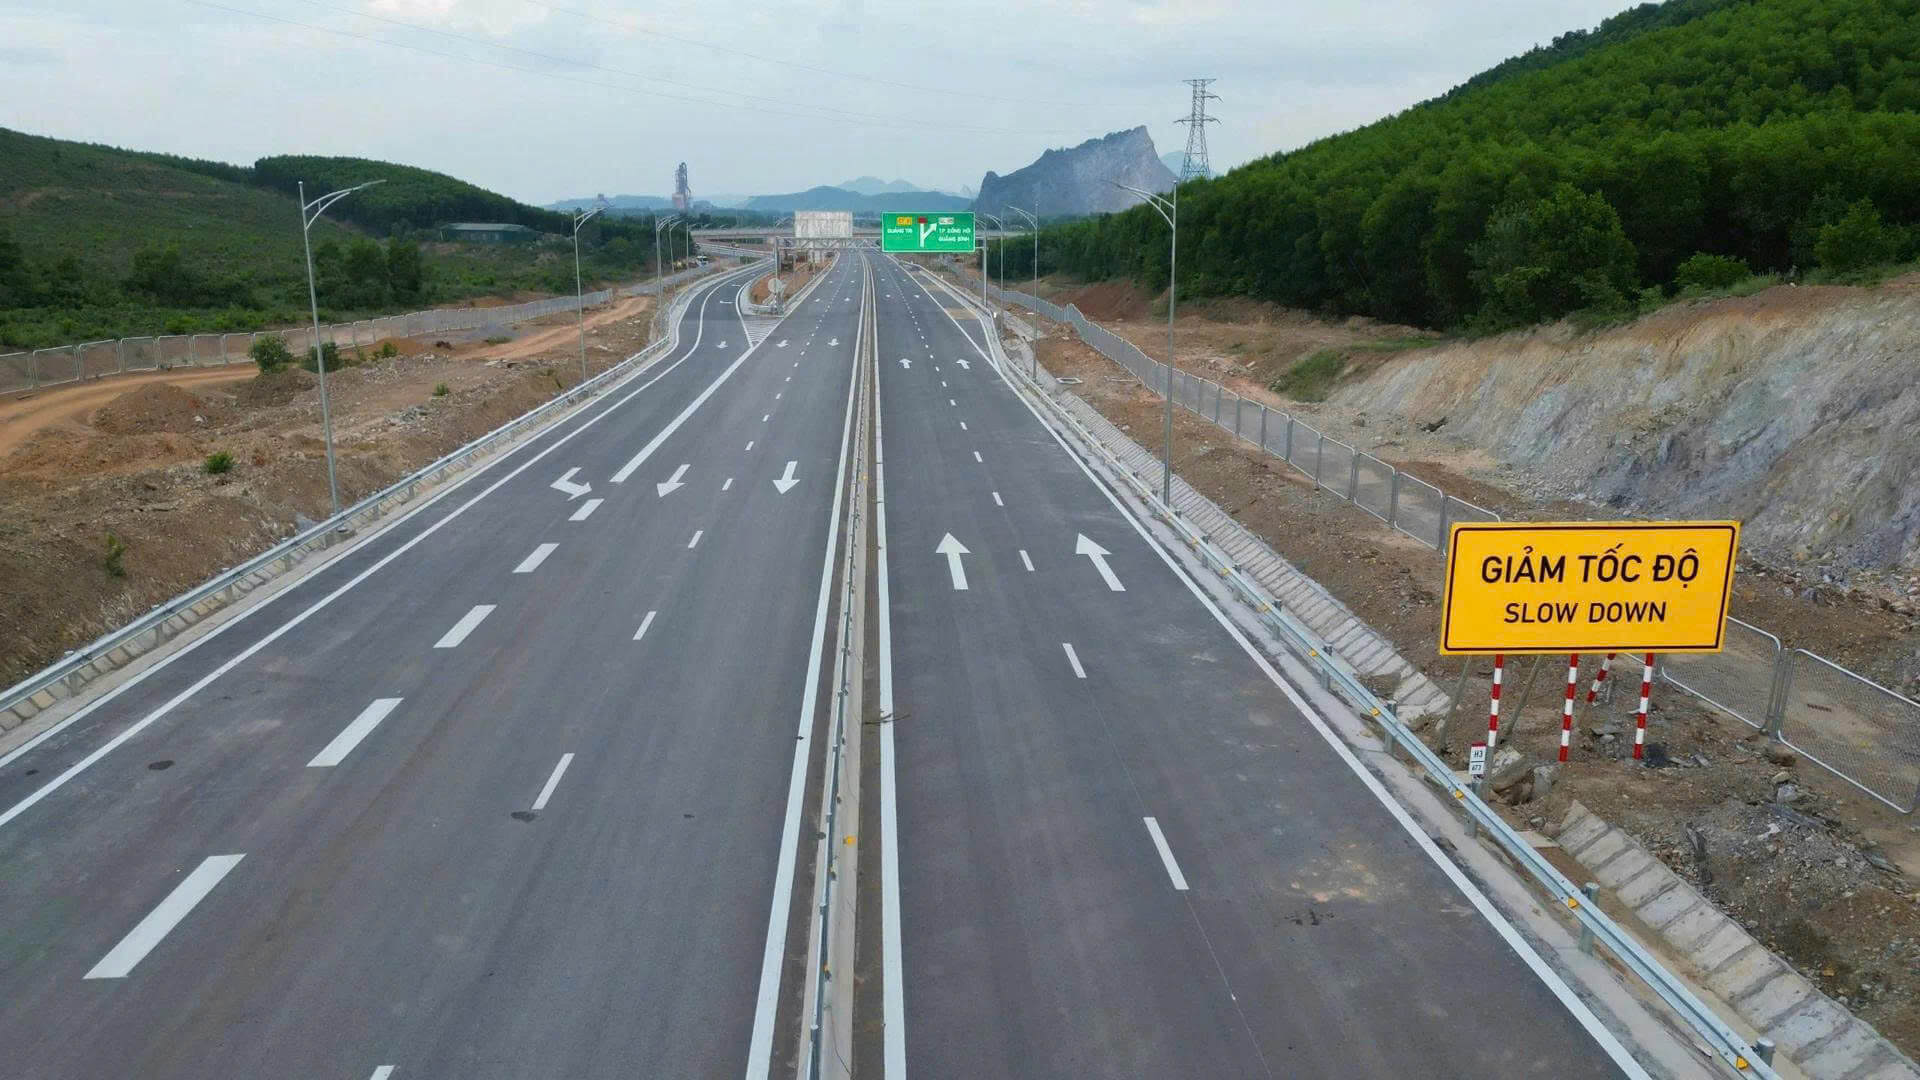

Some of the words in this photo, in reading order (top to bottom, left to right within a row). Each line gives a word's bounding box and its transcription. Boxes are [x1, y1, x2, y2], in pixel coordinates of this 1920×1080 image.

[1481, 545, 1567, 584] GIẢM
[1577, 543, 1642, 583] TỐC
[1652, 548, 1700, 589] ĐỘ
[1503, 602, 1579, 624] SLOW
[1588, 601, 1667, 623] DOWN
